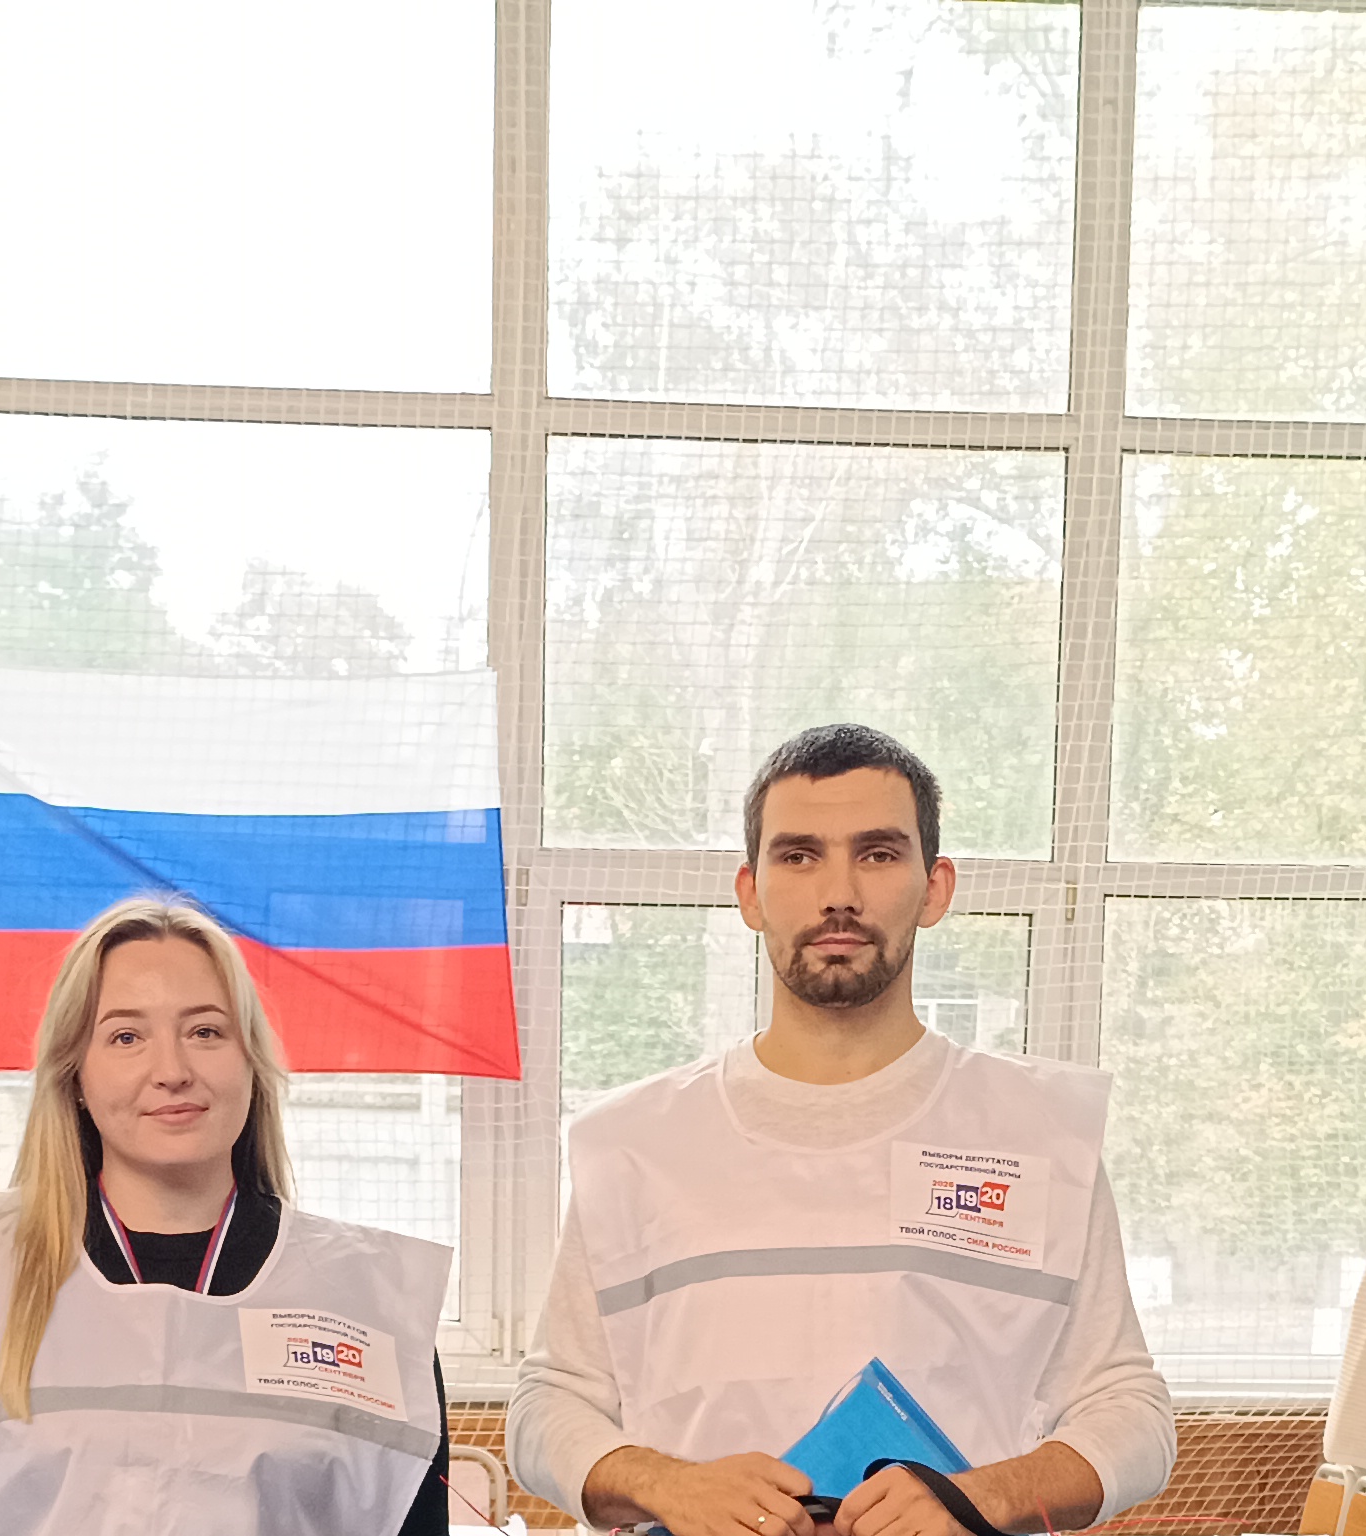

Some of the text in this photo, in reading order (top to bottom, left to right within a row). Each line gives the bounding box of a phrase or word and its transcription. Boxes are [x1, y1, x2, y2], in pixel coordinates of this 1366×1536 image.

[922, 1150, 1020, 1168] ВЫБОРЫ ДЕПУТАТОВ
[919, 1161, 1021, 1179] ГОСУДАРСТВЕННОЙ ДУМЫ
[935, 1187, 1005, 1211] 18 19 20
[959, 1212, 1004, 1228] СЕНТЯБРЯ
[899, 1226, 925, 1236] ТВОЙ
[927, 1229, 957, 1241] ГОЛОС
[967, 1237, 989, 1248] СИЛА
[992, 1243, 1031, 1257] РОССИИ!
[291, 1346, 360, 1364] 18 19 20
[287, 1380, 320, 1389] ГОЛОС
